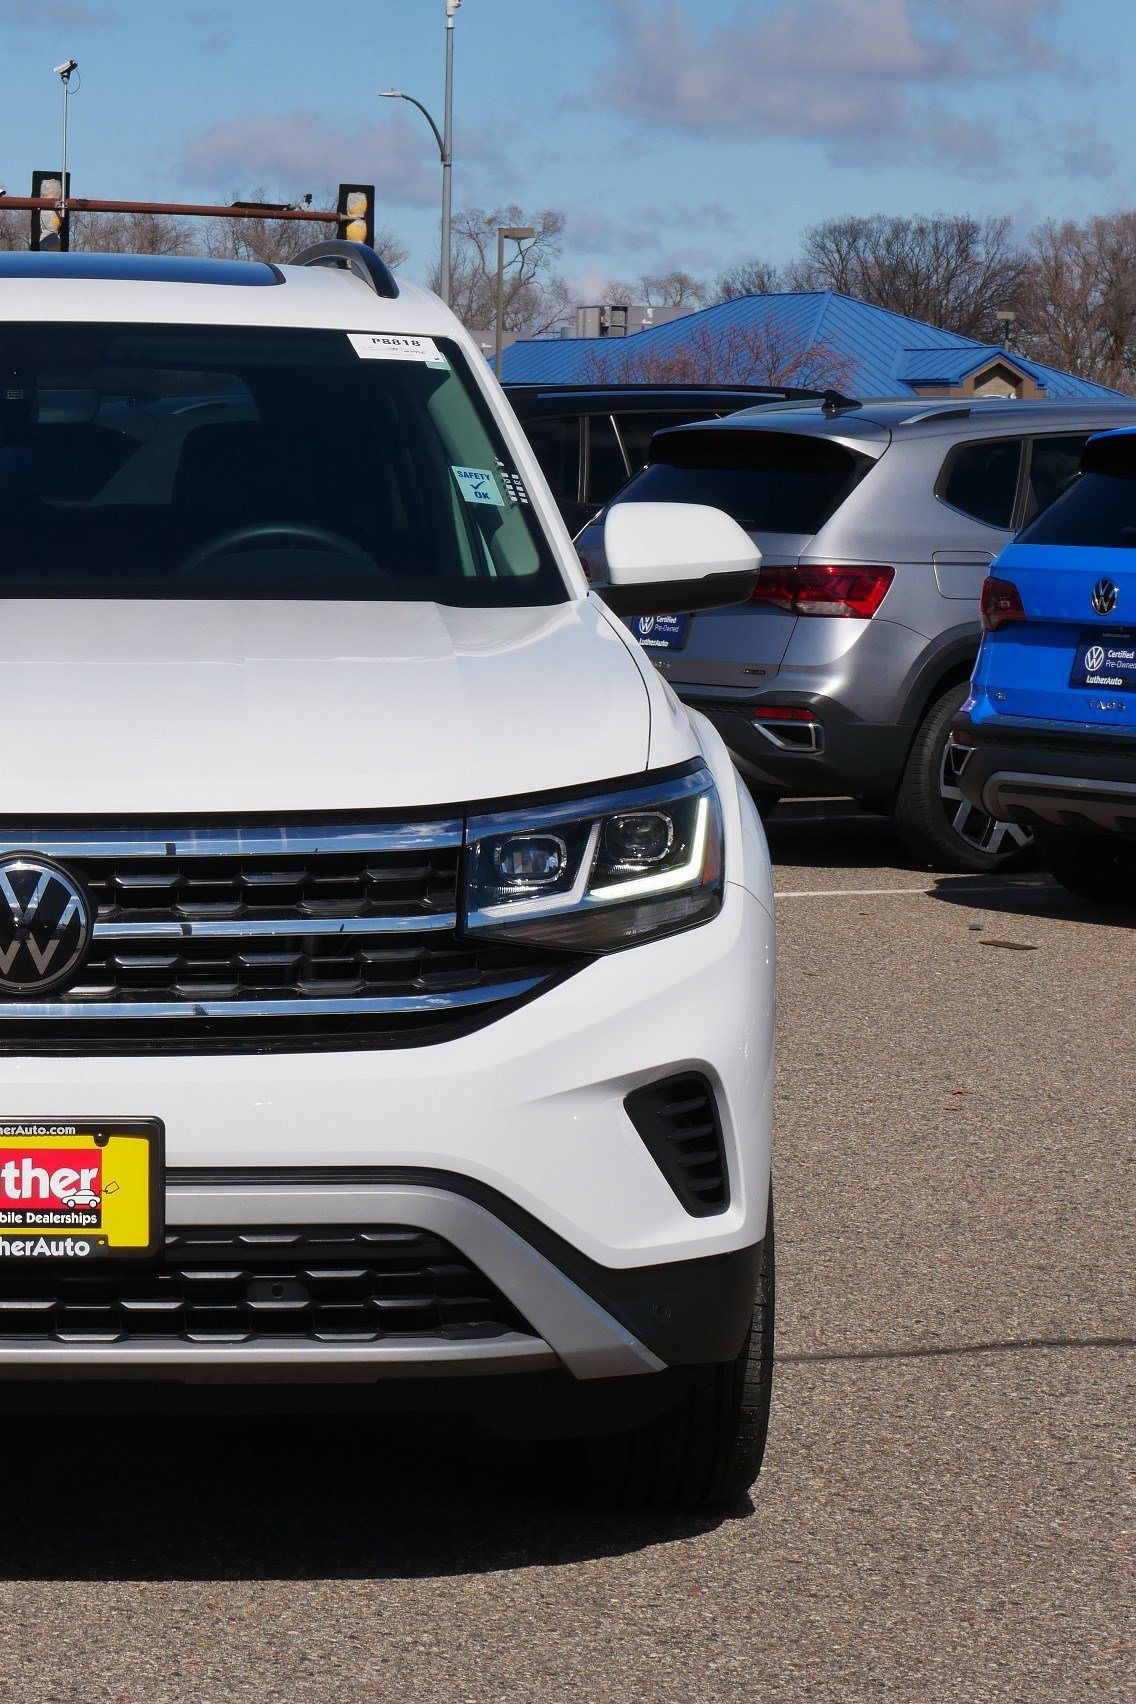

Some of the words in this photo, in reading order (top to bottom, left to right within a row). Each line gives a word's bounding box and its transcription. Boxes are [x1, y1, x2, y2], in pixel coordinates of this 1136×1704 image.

[372, 338, 421, 347] P8818
[457, 470, 490, 481] SAFETY
[474, 491, 491, 499] OK
[655, 624, 679, 632] Pre-Owned
[639, 638, 669, 647] LutherAuto
[1107, 650, 1134, 658] Certified
[1086, 675, 1123, 686] LutherAuto
[26, 1212, 98, 1226] Dealerships
